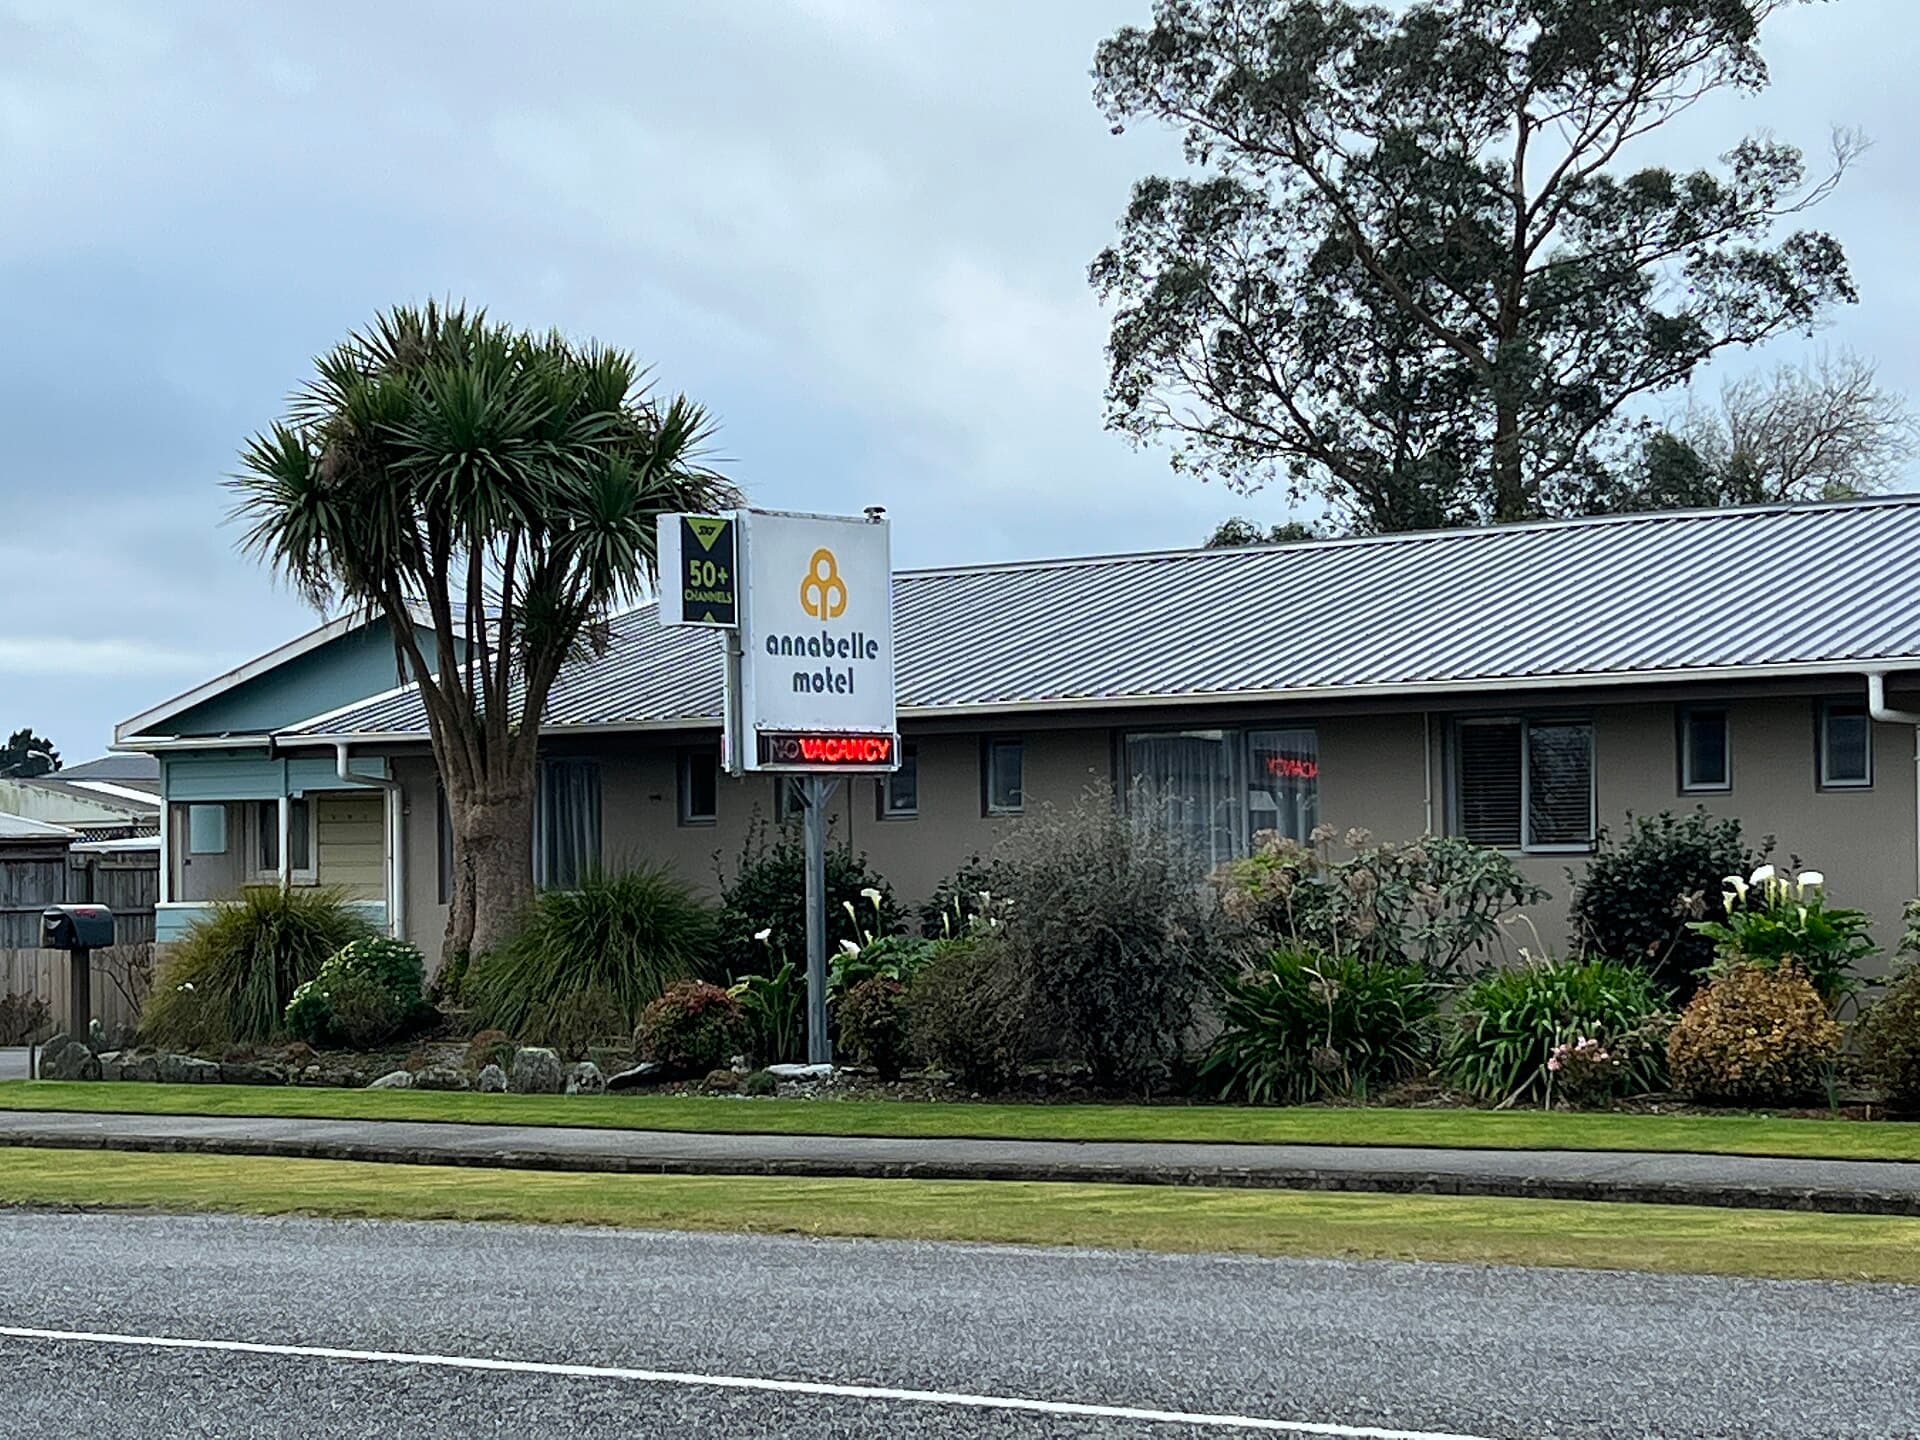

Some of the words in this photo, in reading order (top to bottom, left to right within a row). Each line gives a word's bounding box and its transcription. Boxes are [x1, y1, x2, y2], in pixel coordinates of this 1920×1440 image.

[689, 559, 729, 587] 50+
[684, 588, 732, 604] CHANNELS
[766, 630, 879, 660] annabelle
[793, 666, 854, 694] motel
[771, 738, 799, 759] NO
[799, 738, 891, 762] VACANCY
